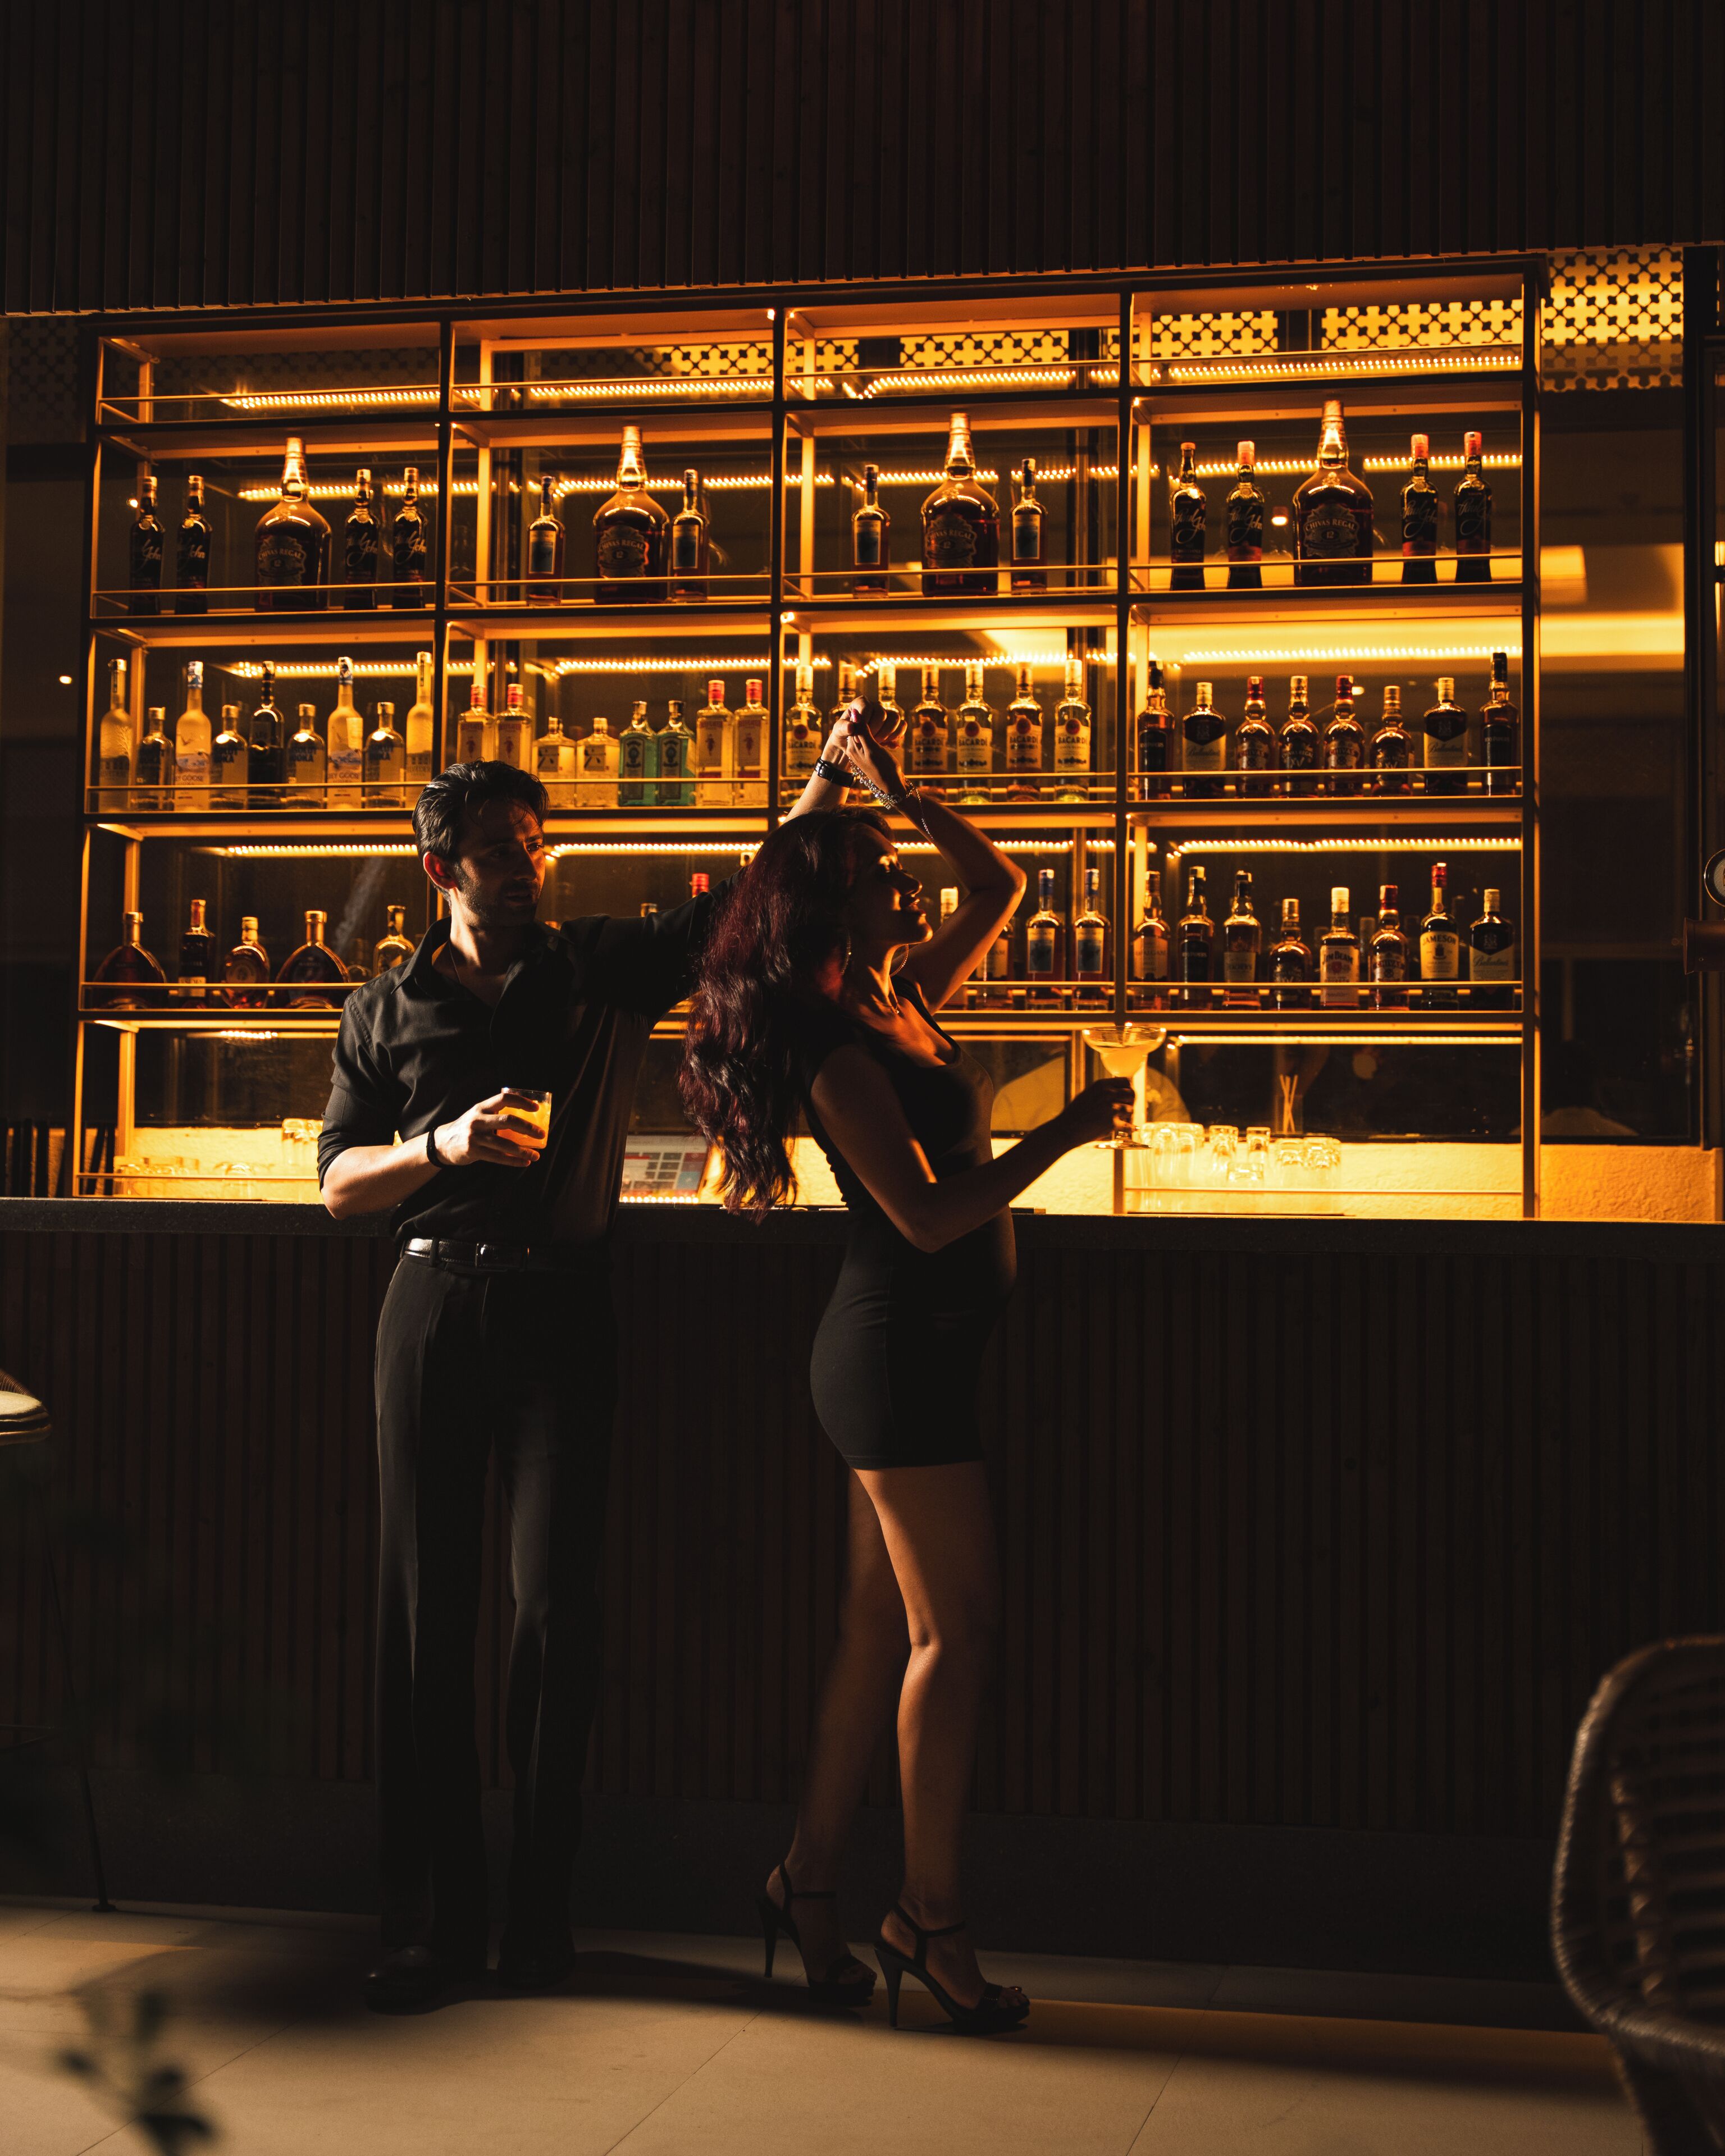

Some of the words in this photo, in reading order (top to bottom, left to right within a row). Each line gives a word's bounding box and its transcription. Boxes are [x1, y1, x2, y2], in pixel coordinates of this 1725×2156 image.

[1305, 520, 1330, 532] CHIVAS
[1331, 519, 1356, 531] REGAL
[948, 529, 973, 540] REGAL
[1326, 530, 1335, 540] 12
[597, 540, 620, 552] CHIVAS
[621, 539, 645, 550] REGAL
[258, 549, 279, 561] CHIVAS
[279, 548, 303, 559] REGAL
[1010, 735, 1038, 743] BACARDI
[1058, 736, 1088, 744] BACARDI
[1422, 934, 1456, 946] JAMESON
